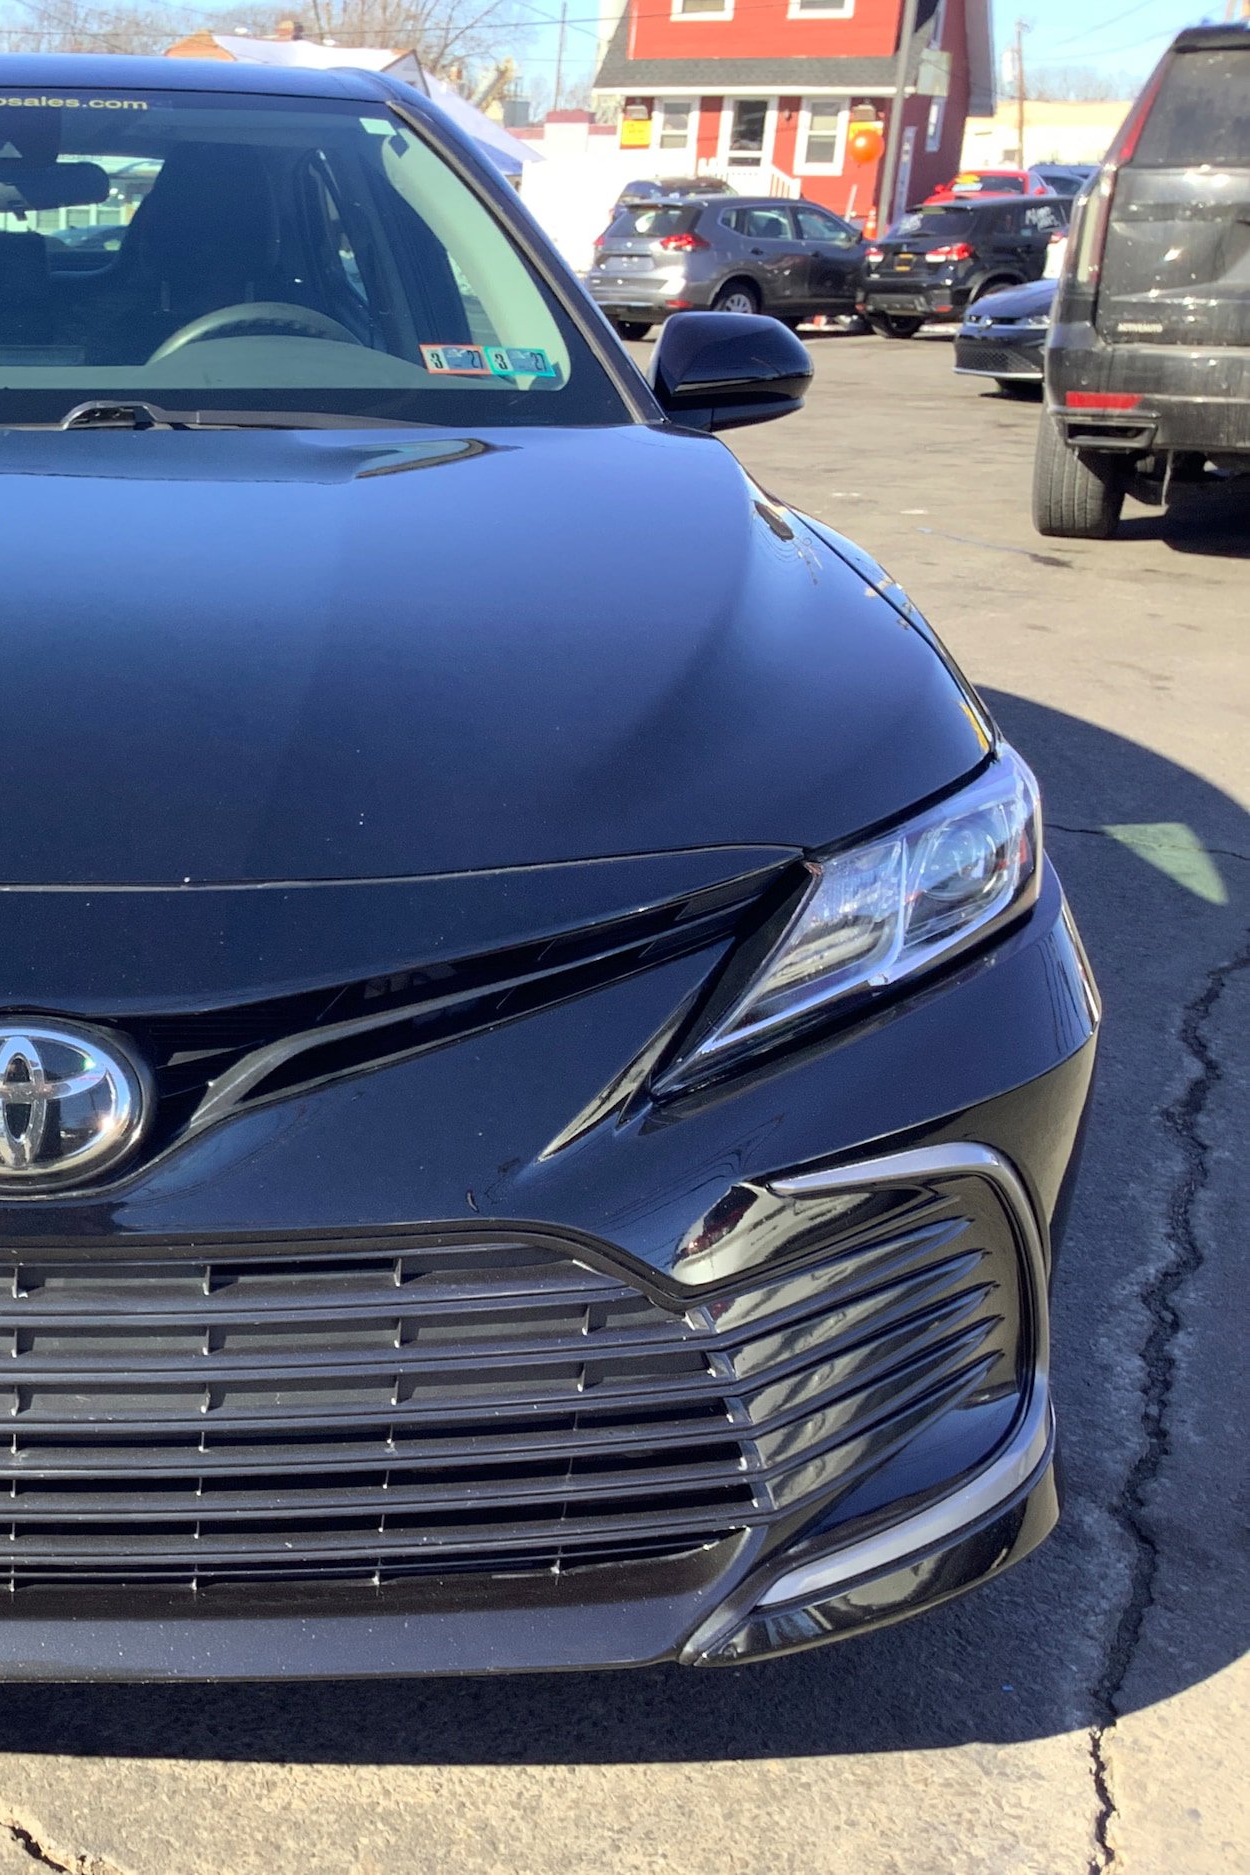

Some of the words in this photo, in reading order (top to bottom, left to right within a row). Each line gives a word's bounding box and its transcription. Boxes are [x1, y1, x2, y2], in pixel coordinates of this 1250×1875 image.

[430, 352, 444, 369] 3
[466, 350, 484, 369] 27
[494, 353, 508, 370] 3
